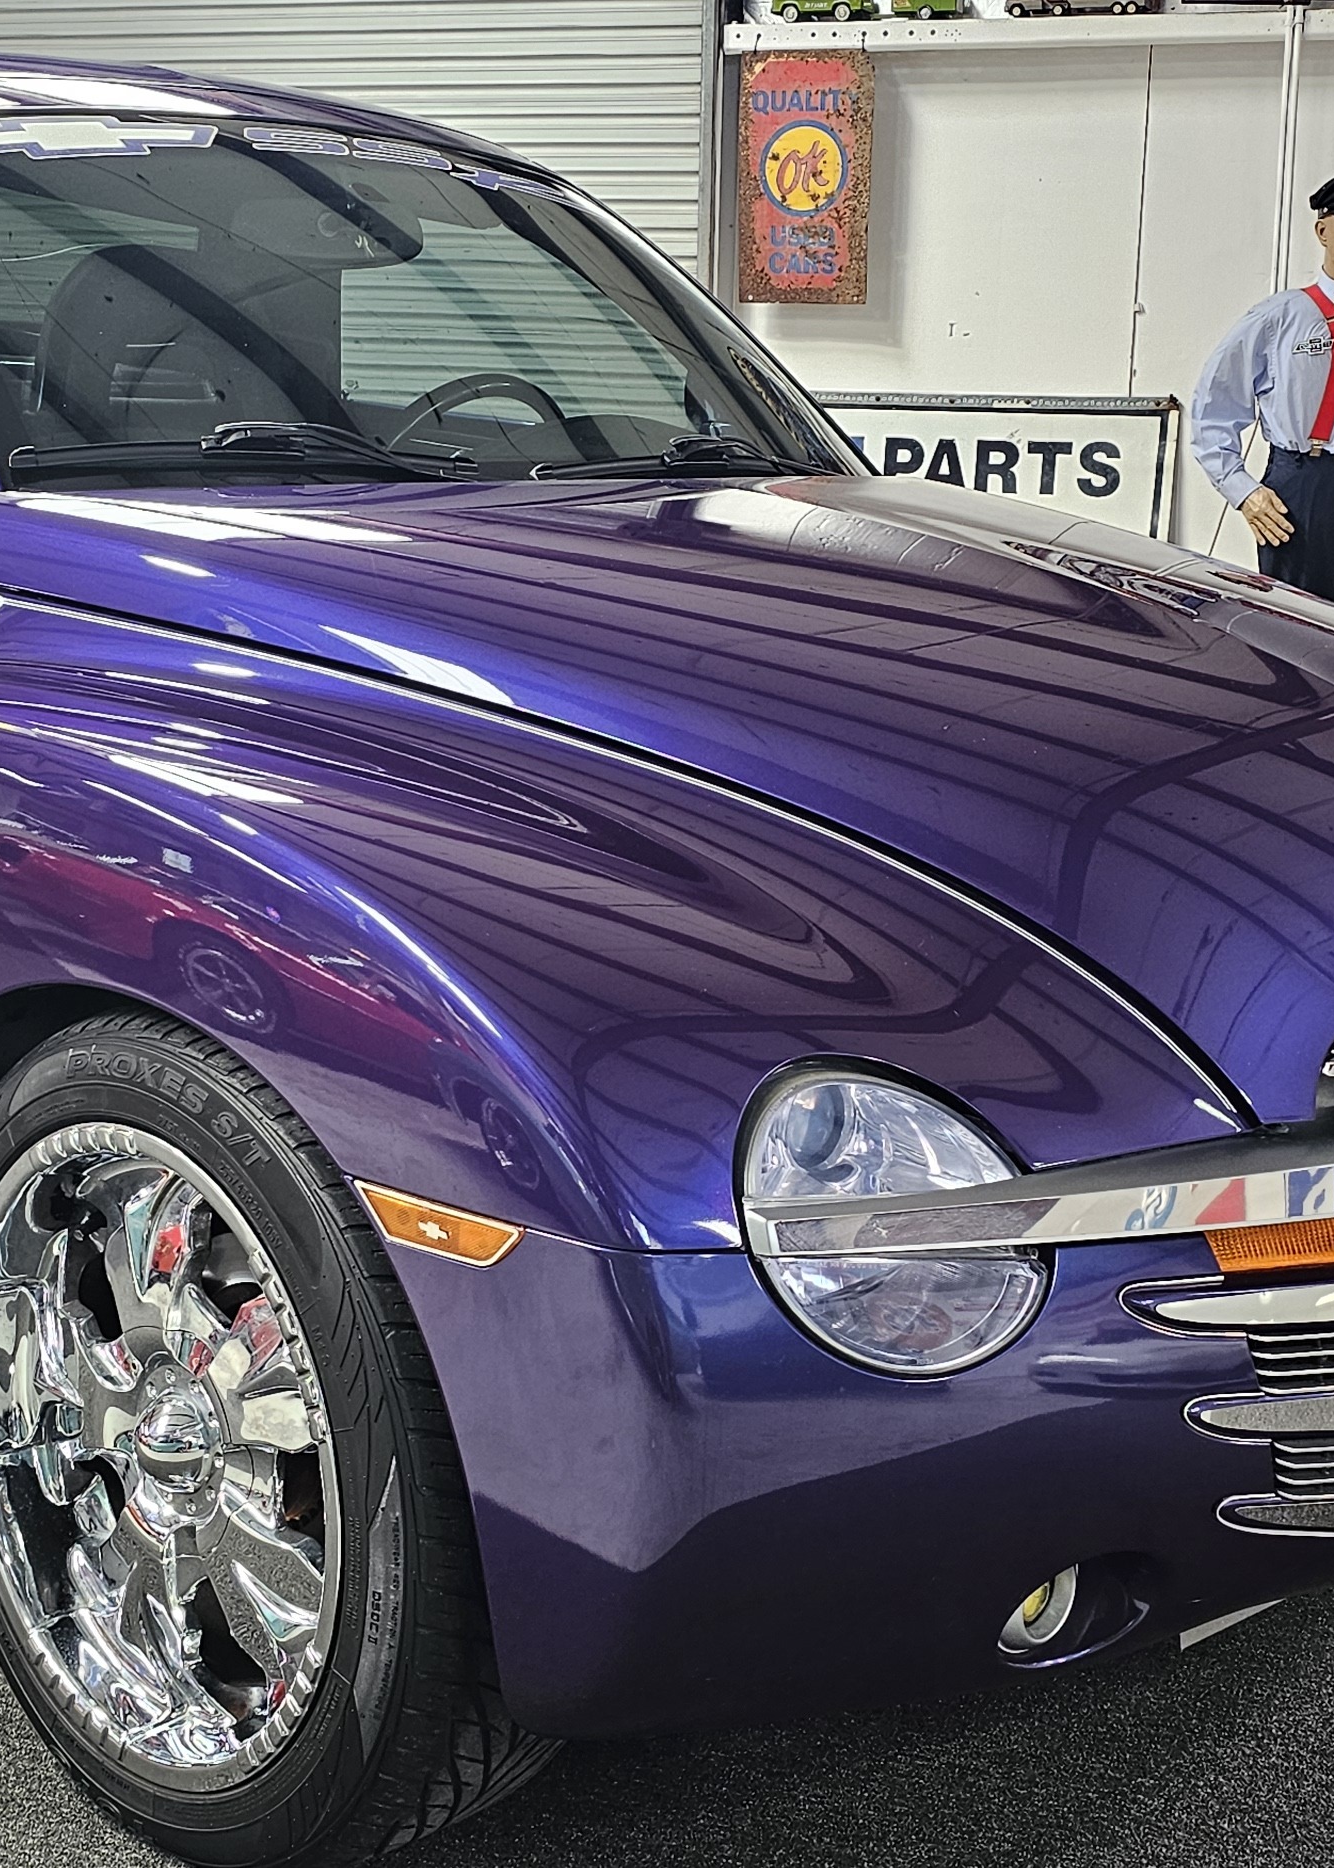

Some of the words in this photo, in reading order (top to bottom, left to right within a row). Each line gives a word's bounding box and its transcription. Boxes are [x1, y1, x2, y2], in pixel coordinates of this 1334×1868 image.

[775, 140, 830, 196] OK
[768, 252, 838, 275] CARS
[883, 436, 1122, 497] PARTS
[65, 1045, 210, 1116] PROXES
[210, 1110, 272, 1168] S/T
